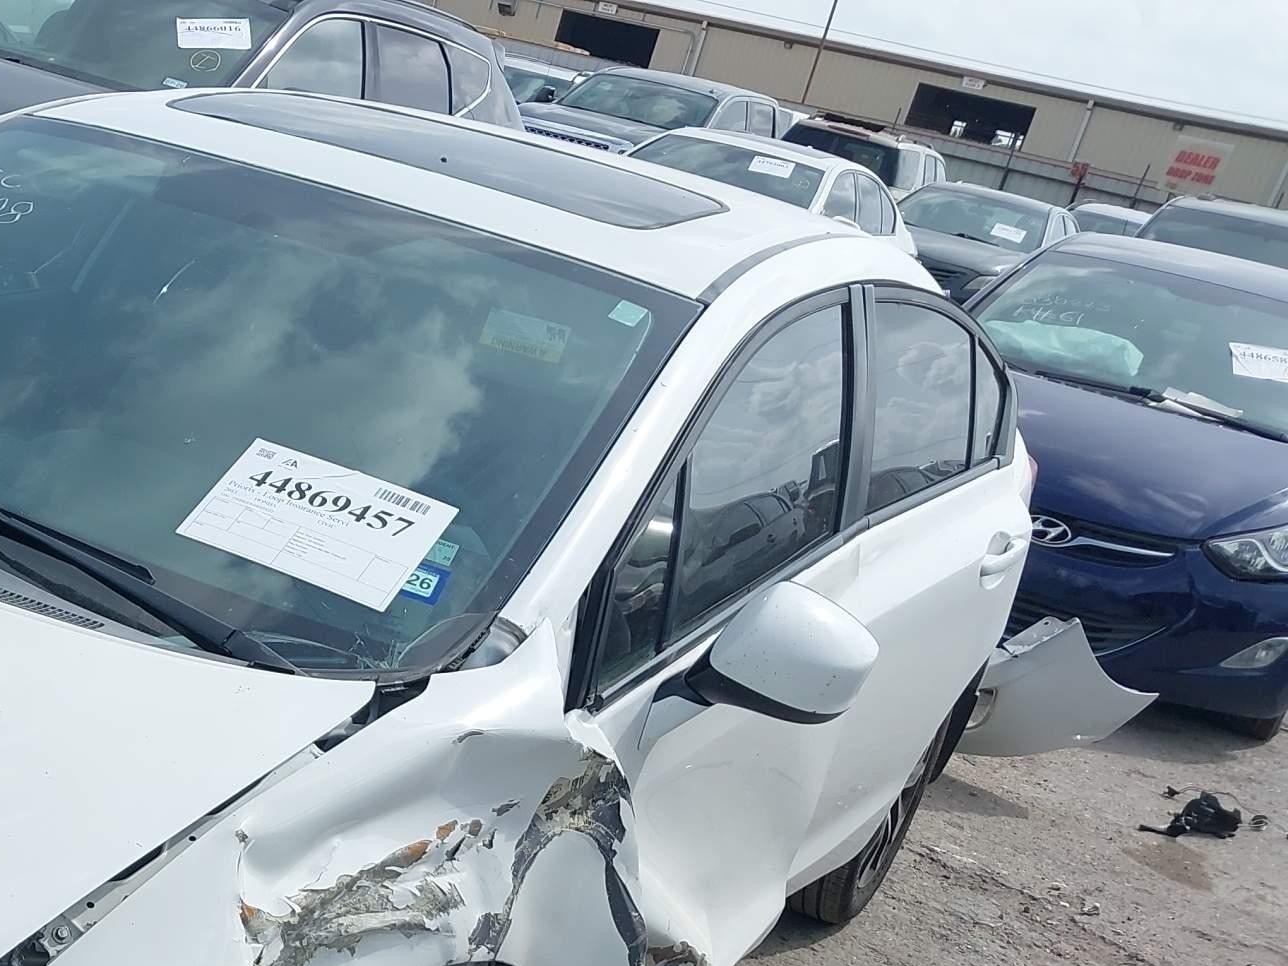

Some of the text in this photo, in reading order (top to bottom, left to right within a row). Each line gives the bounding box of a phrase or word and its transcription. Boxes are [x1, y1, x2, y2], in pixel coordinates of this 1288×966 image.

[248, 470, 415, 537] 44869457
[286, 499, 326, 517] Insurance
[406, 572, 433, 590] 26
